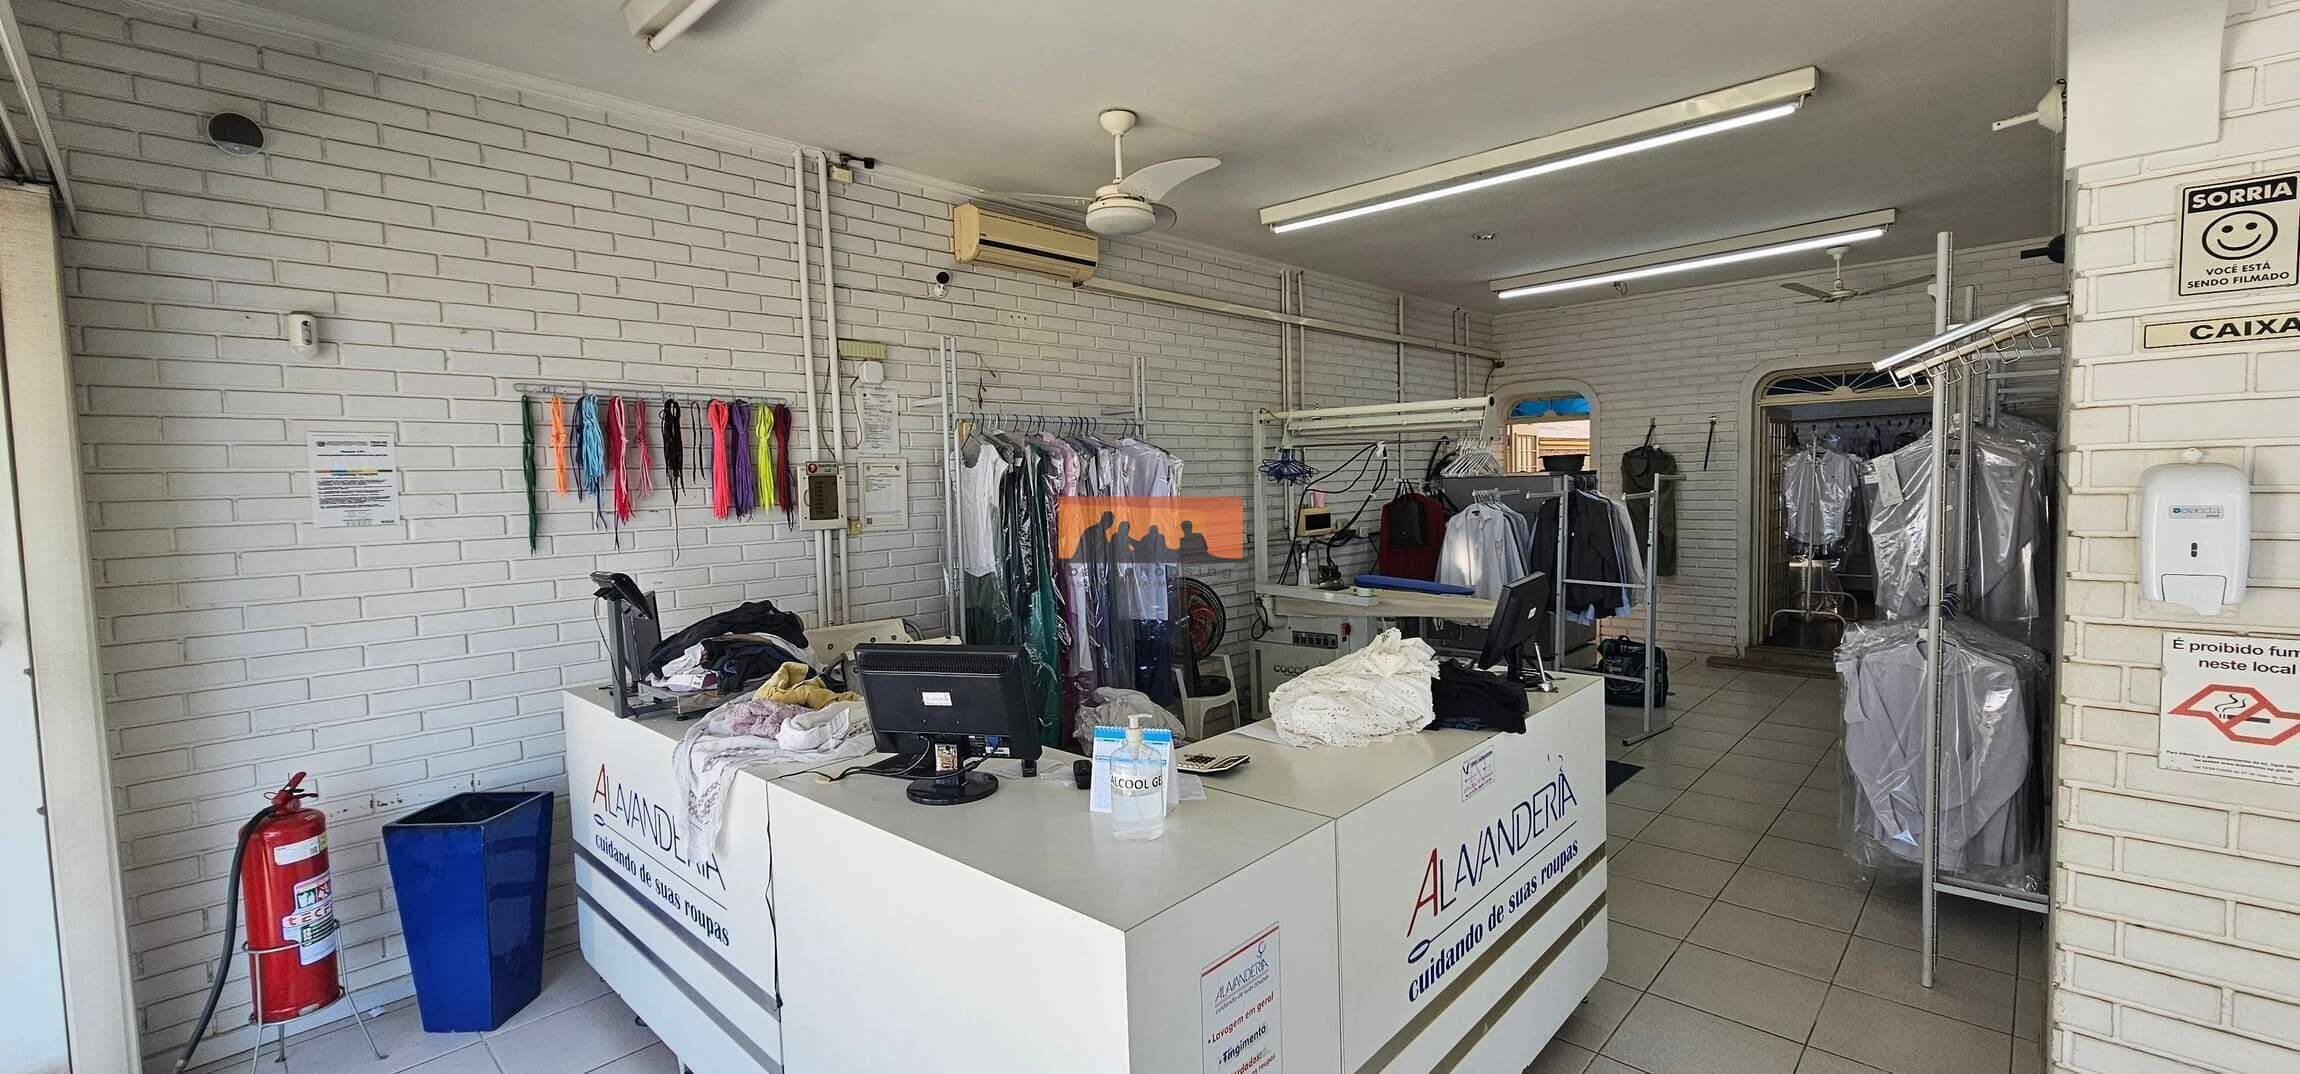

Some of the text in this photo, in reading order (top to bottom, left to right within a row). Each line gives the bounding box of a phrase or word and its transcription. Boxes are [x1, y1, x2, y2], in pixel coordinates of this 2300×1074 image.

[2191, 182, 2293, 209] SORRIA
[2206, 260, 2271, 276] VOCÊ ESTÁ
[2187, 271, 2290, 289] SENDO FILMADO
[2189, 317, 2300, 340] CAIXA
[2173, 637, 2185, 650] É
[2189, 642, 2264, 656] proibido
[2199, 660, 2297, 675] neste local
[1111, 773, 1149, 790] ALCOOL
[595, 834, 730, 947] cuidando de suas roupas
[1408, 839, 1578, 1002] cuidando de suas roupas
[1211, 990, 1274, 1043] Lavagem em geral
[1222, 1024, 1267, 1063] Tingimento
